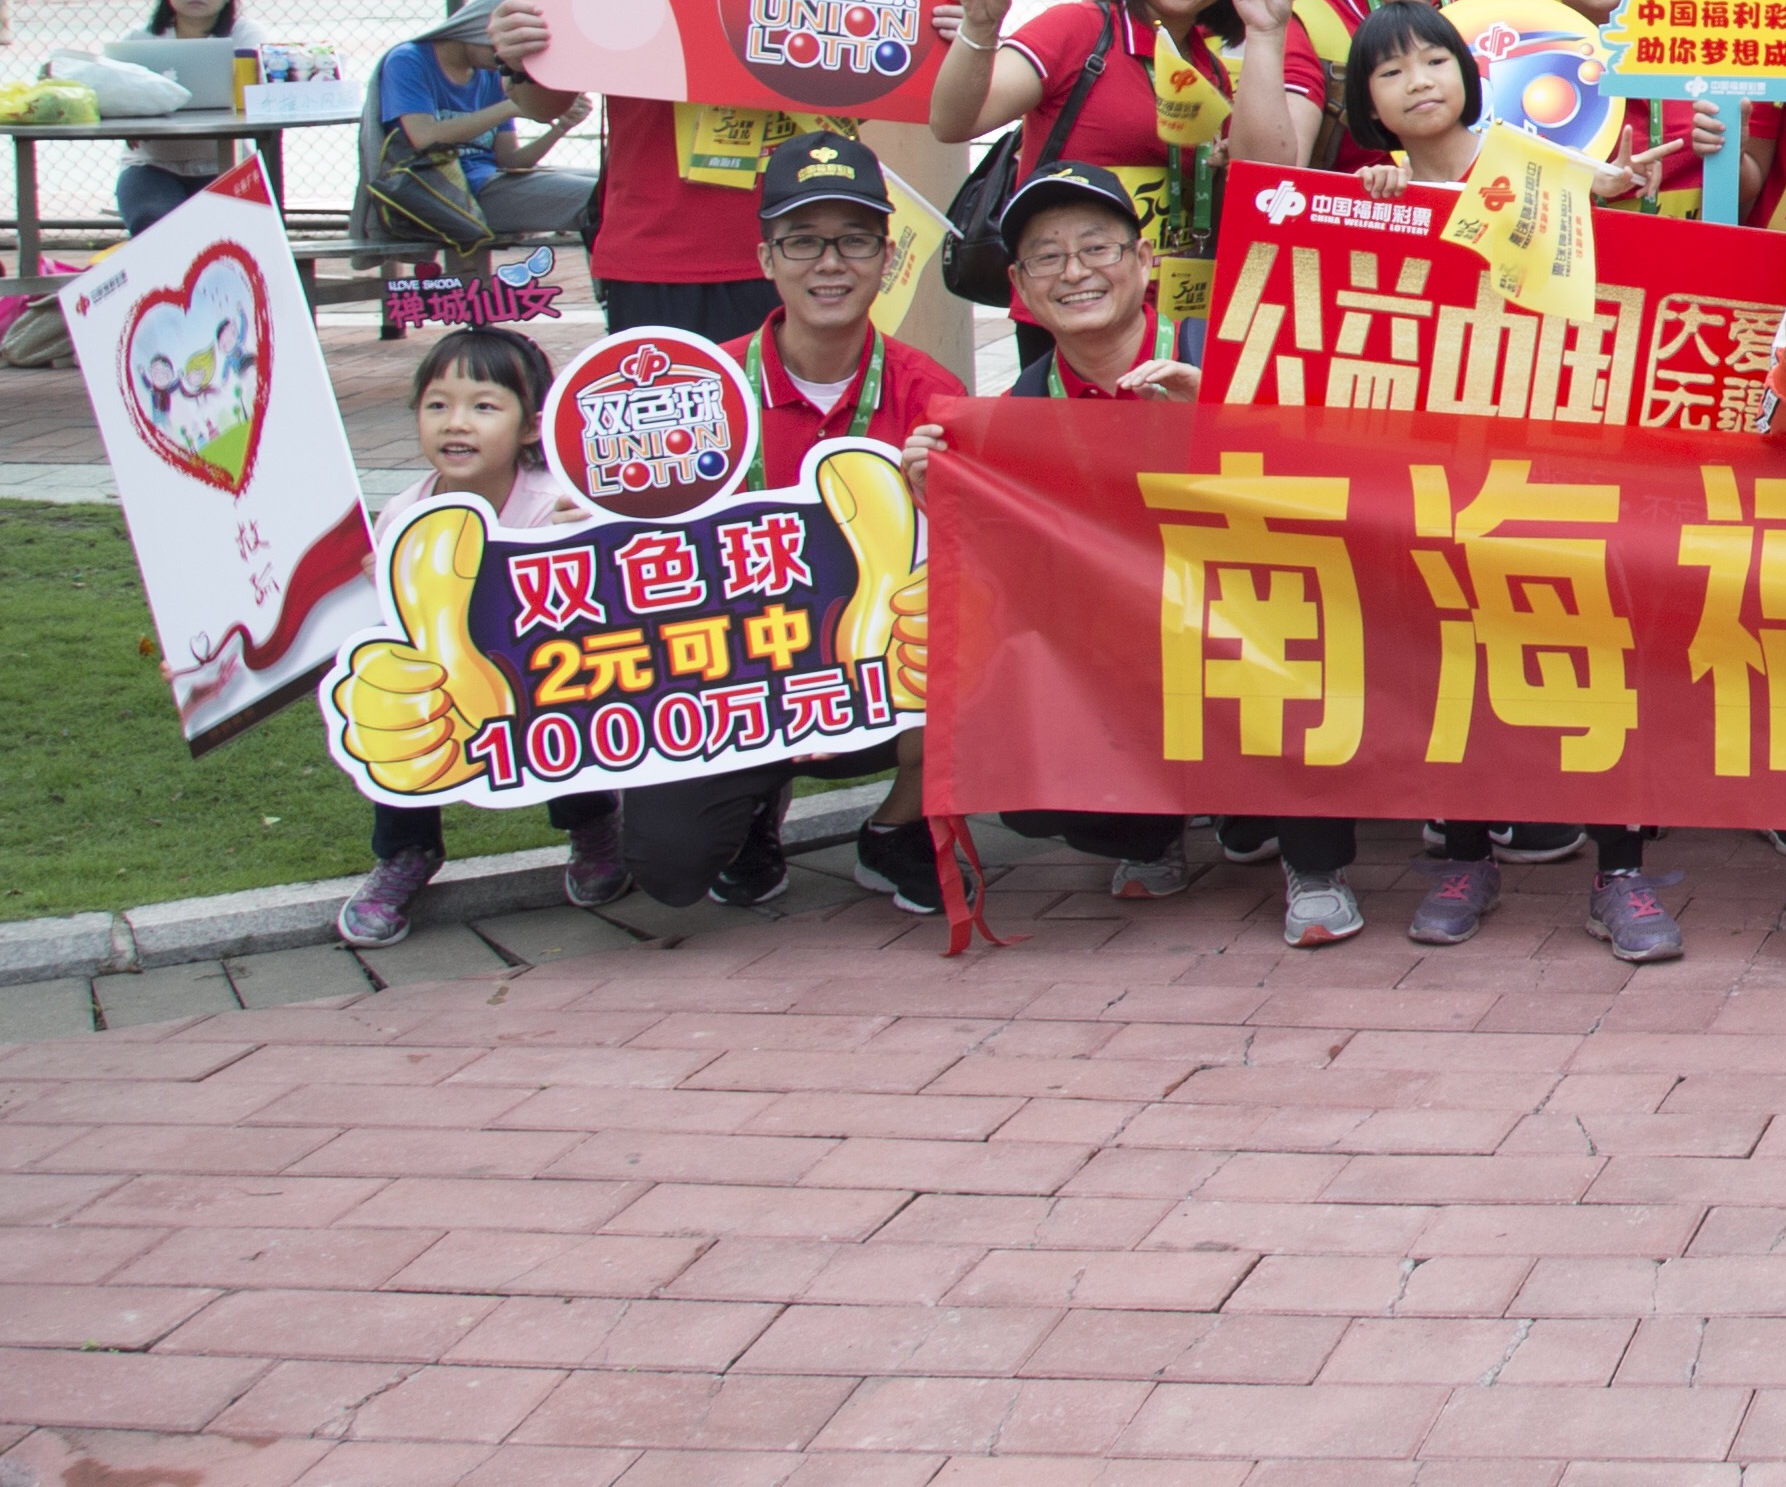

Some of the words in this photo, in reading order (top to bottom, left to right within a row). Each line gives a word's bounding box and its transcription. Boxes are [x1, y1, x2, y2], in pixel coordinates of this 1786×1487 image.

[747, 25, 911, 76] LOTTO
[1309, 213, 1342, 226] CHINA
[1344, 217, 1387, 233] WELFARE
[1389, 222, 1430, 237] LOTTERY
[1310, 192, 1433, 229] 中国福利彩票
[385, 277, 563, 328] 禅城仙女
[579, 377, 726, 438] 双色球
[584, 420, 731, 467] UNION
[588, 450, 729, 498] LOTTO
[507, 511, 812, 638] 双色球
[530, 603, 811, 707] 2元可中
[469, 660, 892, 786] 1000万元！
